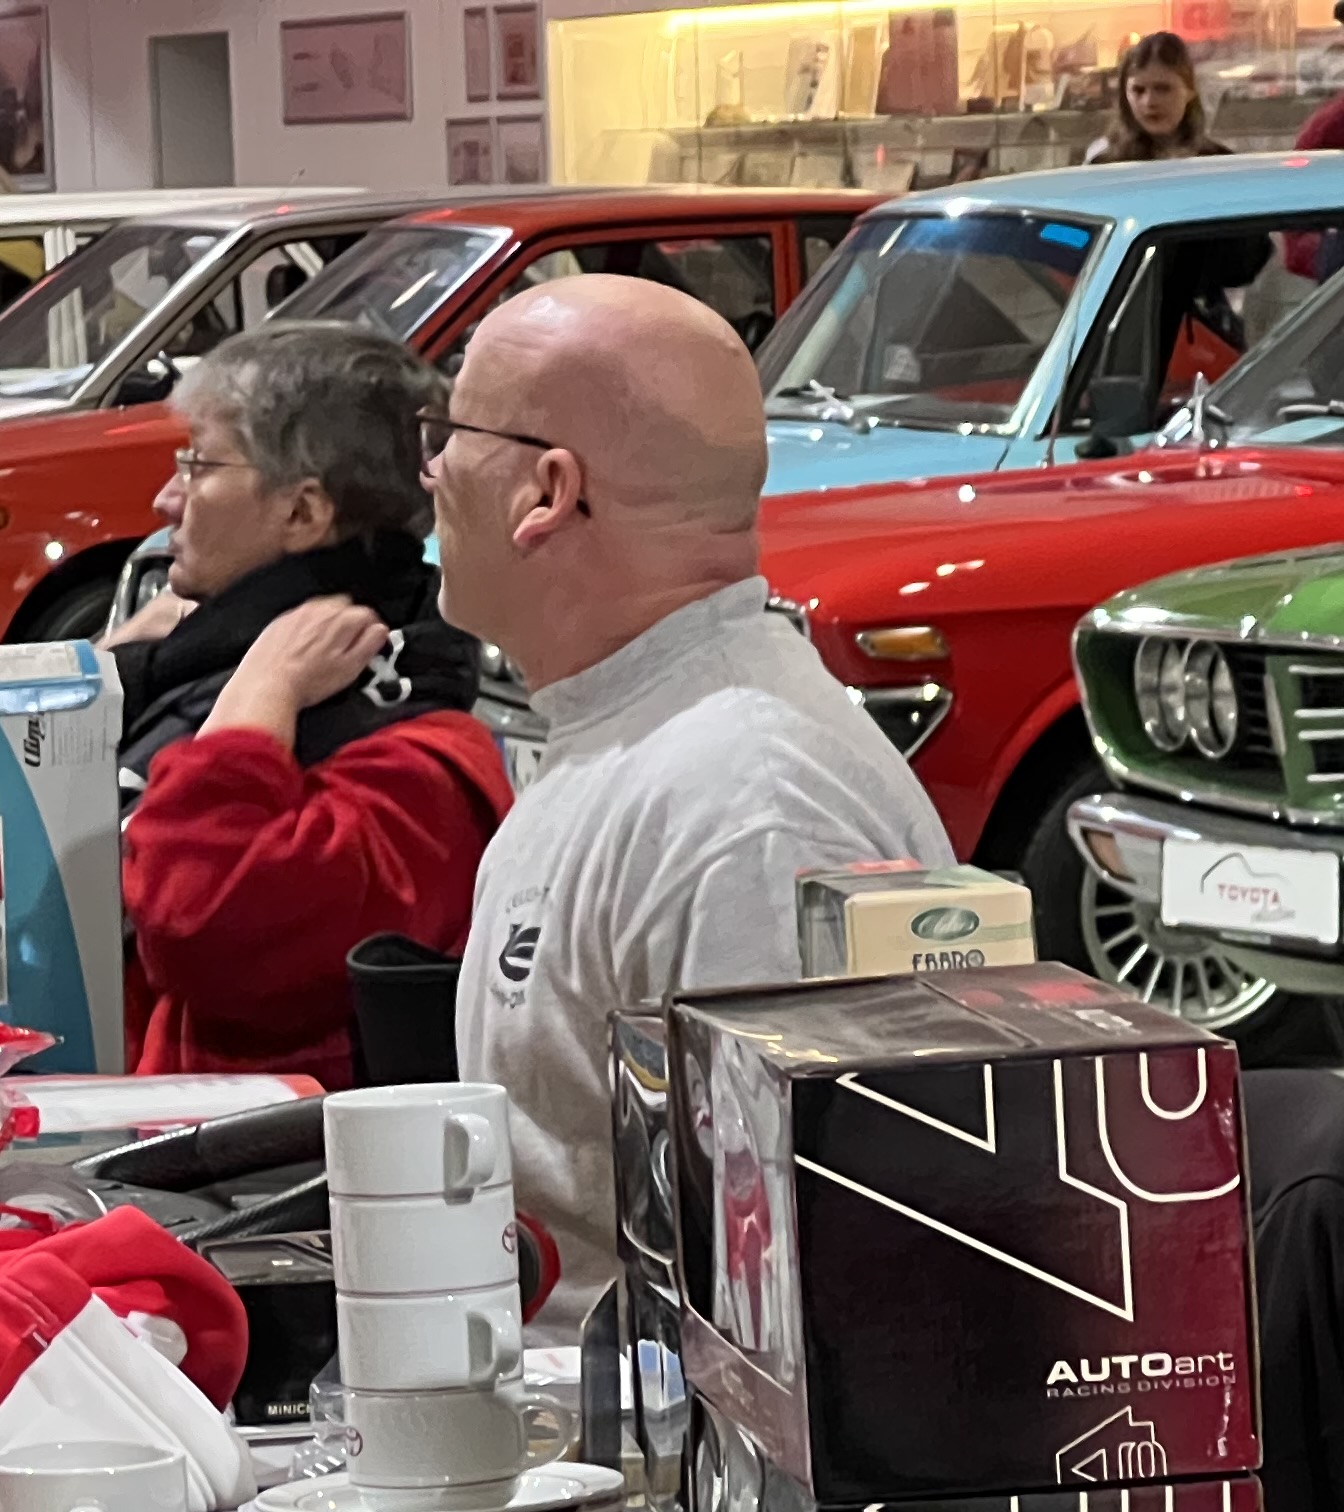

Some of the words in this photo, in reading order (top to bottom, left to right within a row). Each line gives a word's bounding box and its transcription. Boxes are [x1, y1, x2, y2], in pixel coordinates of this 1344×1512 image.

[1218, 883, 1281, 903] TOYOTA
[1046, 1350, 1235, 1386] AUTOart
[1046, 1381, 1131, 1399] RACING
[1137, 1374, 1236, 1392] DIVISION
